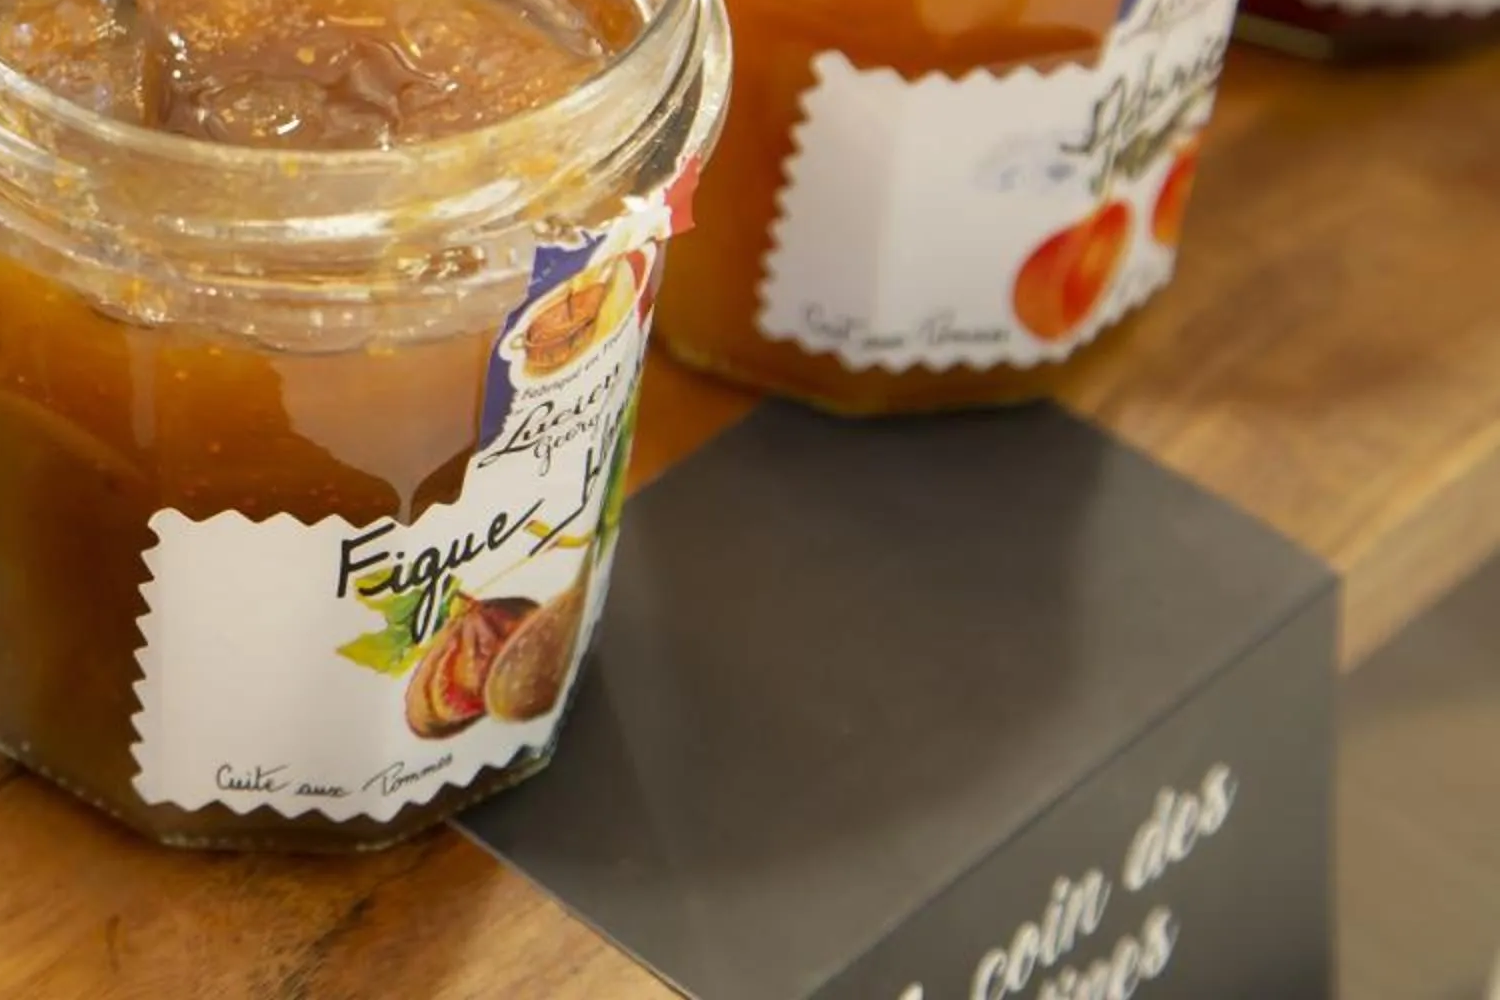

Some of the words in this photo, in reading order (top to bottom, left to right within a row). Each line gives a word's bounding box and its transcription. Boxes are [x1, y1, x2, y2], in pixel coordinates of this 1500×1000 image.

[336, 498, 546, 645] Figue
[295, 780, 352, 798] aux
[968, 868, 1113, 1000] coin
[1121, 761, 1239, 892] des
